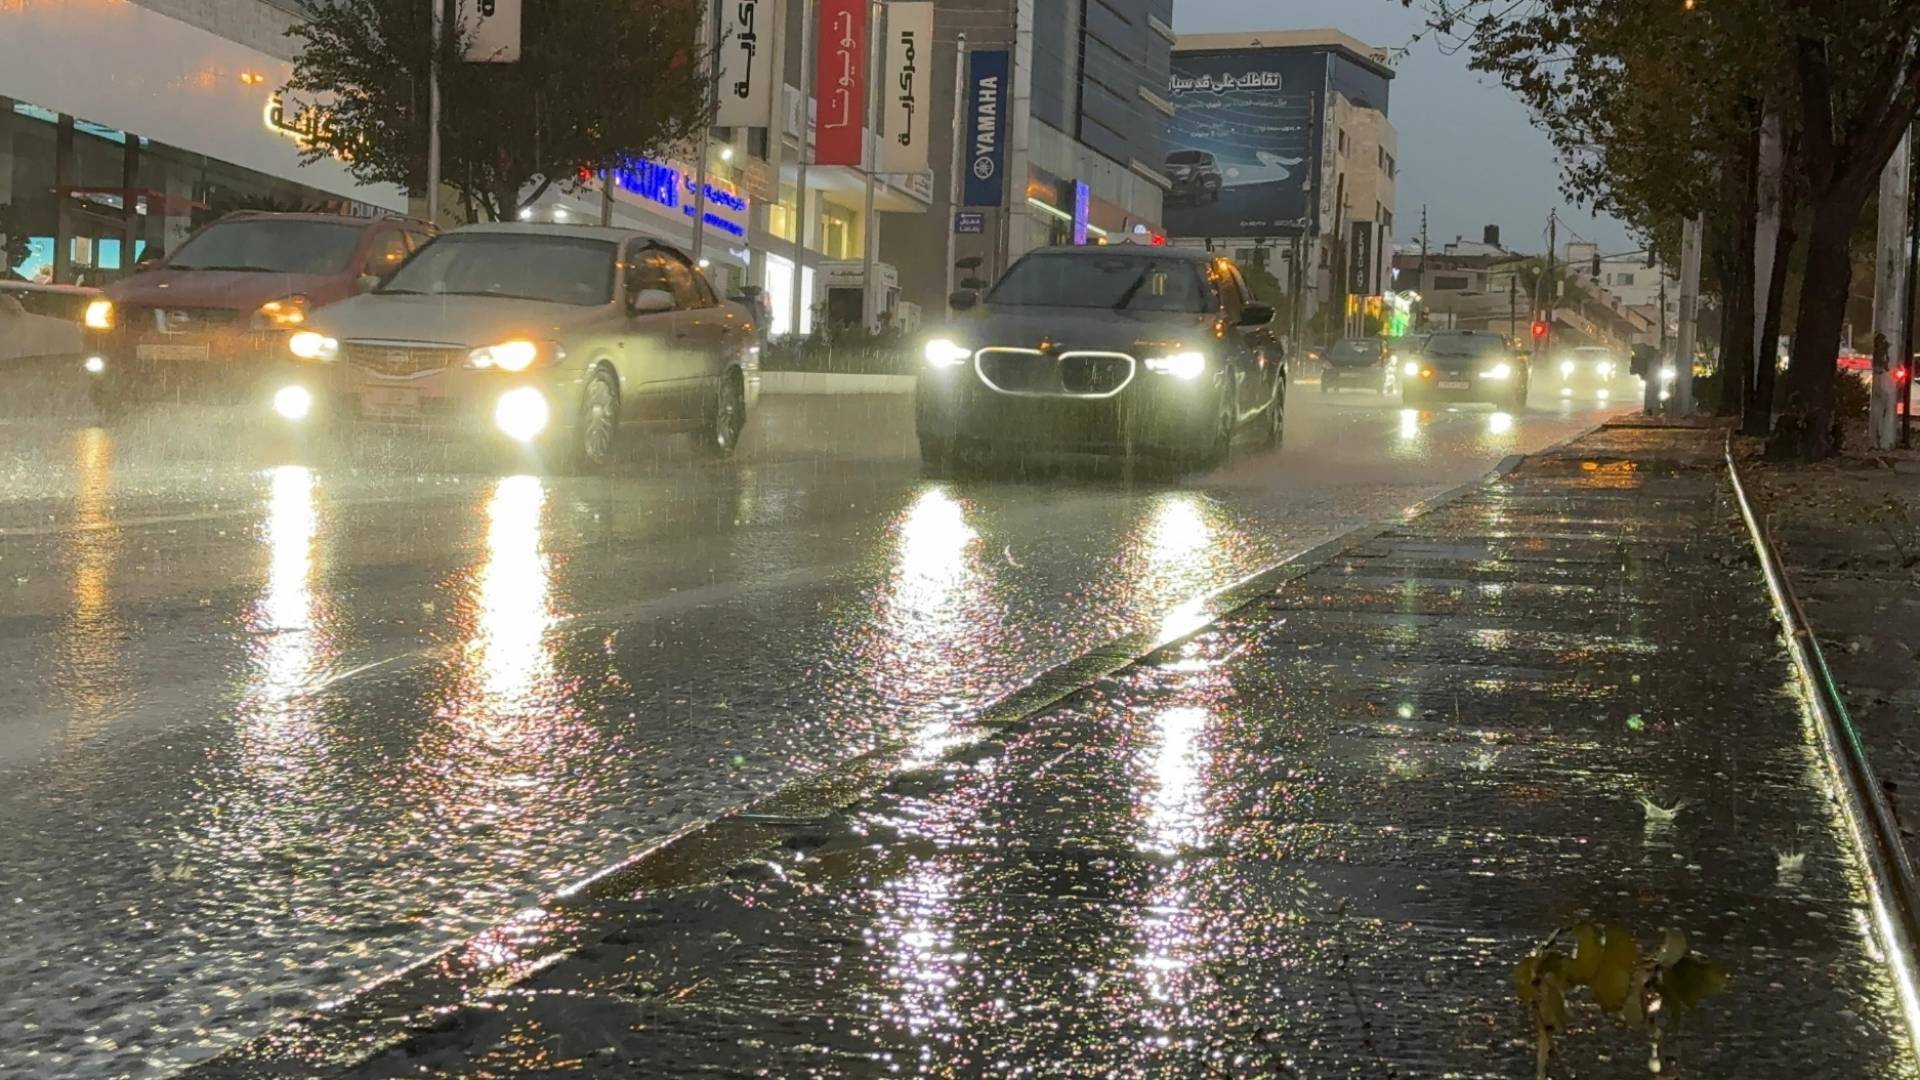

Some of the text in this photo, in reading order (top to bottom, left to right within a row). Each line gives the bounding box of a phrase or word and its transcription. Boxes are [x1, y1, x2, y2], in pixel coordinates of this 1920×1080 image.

[825, 10, 856, 130] تويوتا
[898, 31, 915, 146] المركزية
[975, 76, 998, 155] YAMAHA
